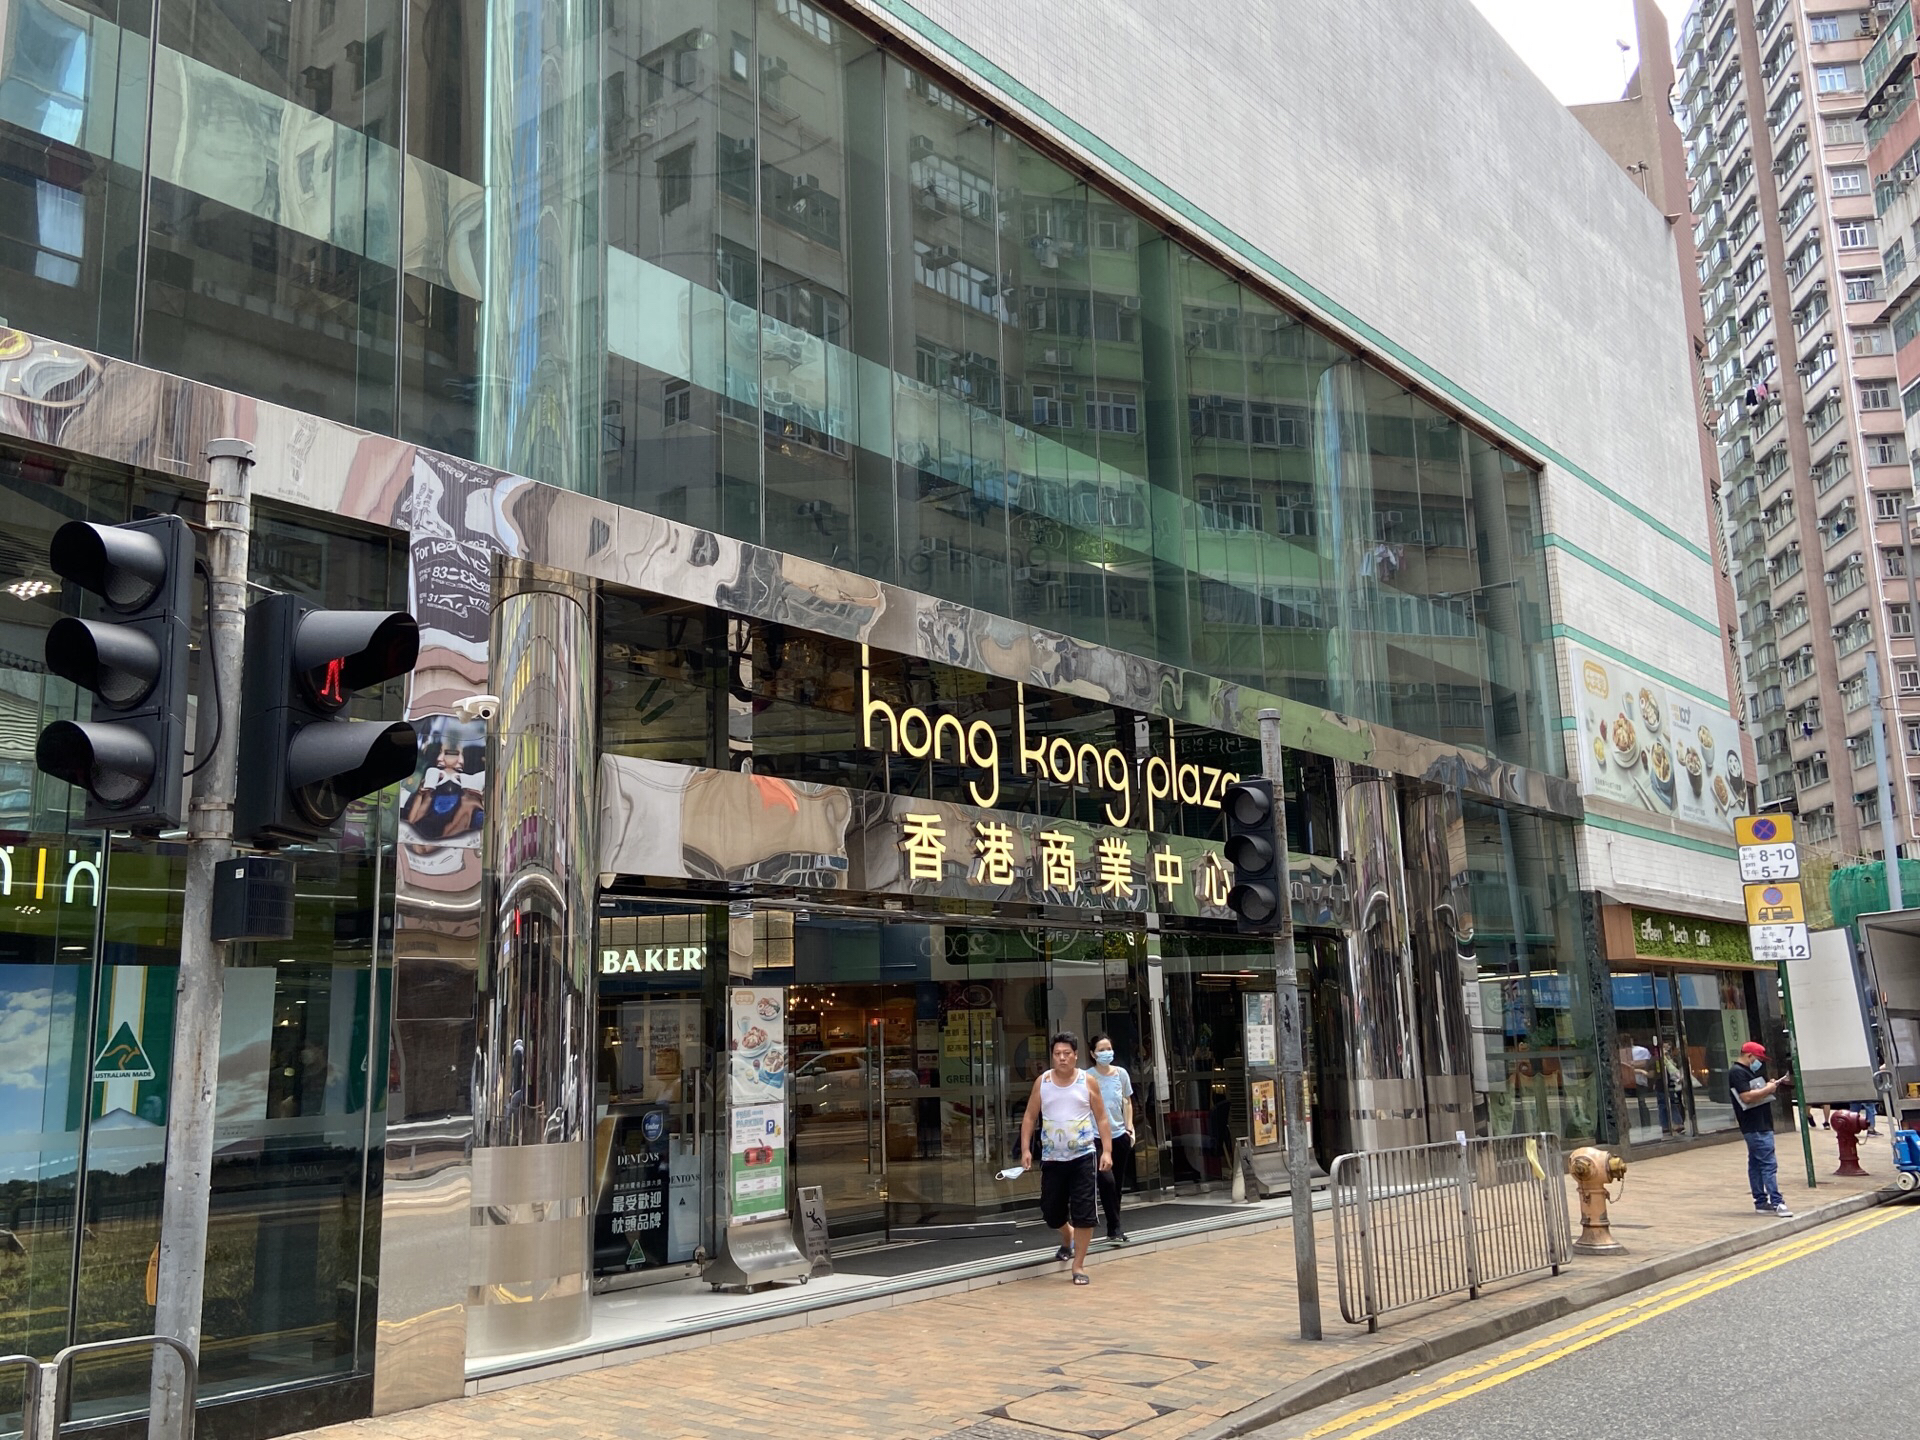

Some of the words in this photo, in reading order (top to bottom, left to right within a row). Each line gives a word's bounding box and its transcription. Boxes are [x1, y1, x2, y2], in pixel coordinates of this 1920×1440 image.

[860, 643, 999, 809] hong
[1016, 681, 1131, 829] kong
[902, 812, 1231, 907] 香港商業中心
[1759, 848, 1795, 862] 8-10
[1761, 865, 1789, 878] 5-7
[1641, 917, 1663, 941] Green
[1784, 926, 1795, 938] 7
[1754, 944, 1785, 952] midnight
[1788, 945, 1806, 957] 12
[602, 946, 707, 974] BAKER
[94, 1071, 132, 1080] USTRALIAN
[132, 1070, 152, 1078] MADE
[670, 1173, 700, 1185] ENTONS
[611, 1191, 662, 1213] 最受歡迎
[611, 1211, 662, 1234] 枕頭品牌
